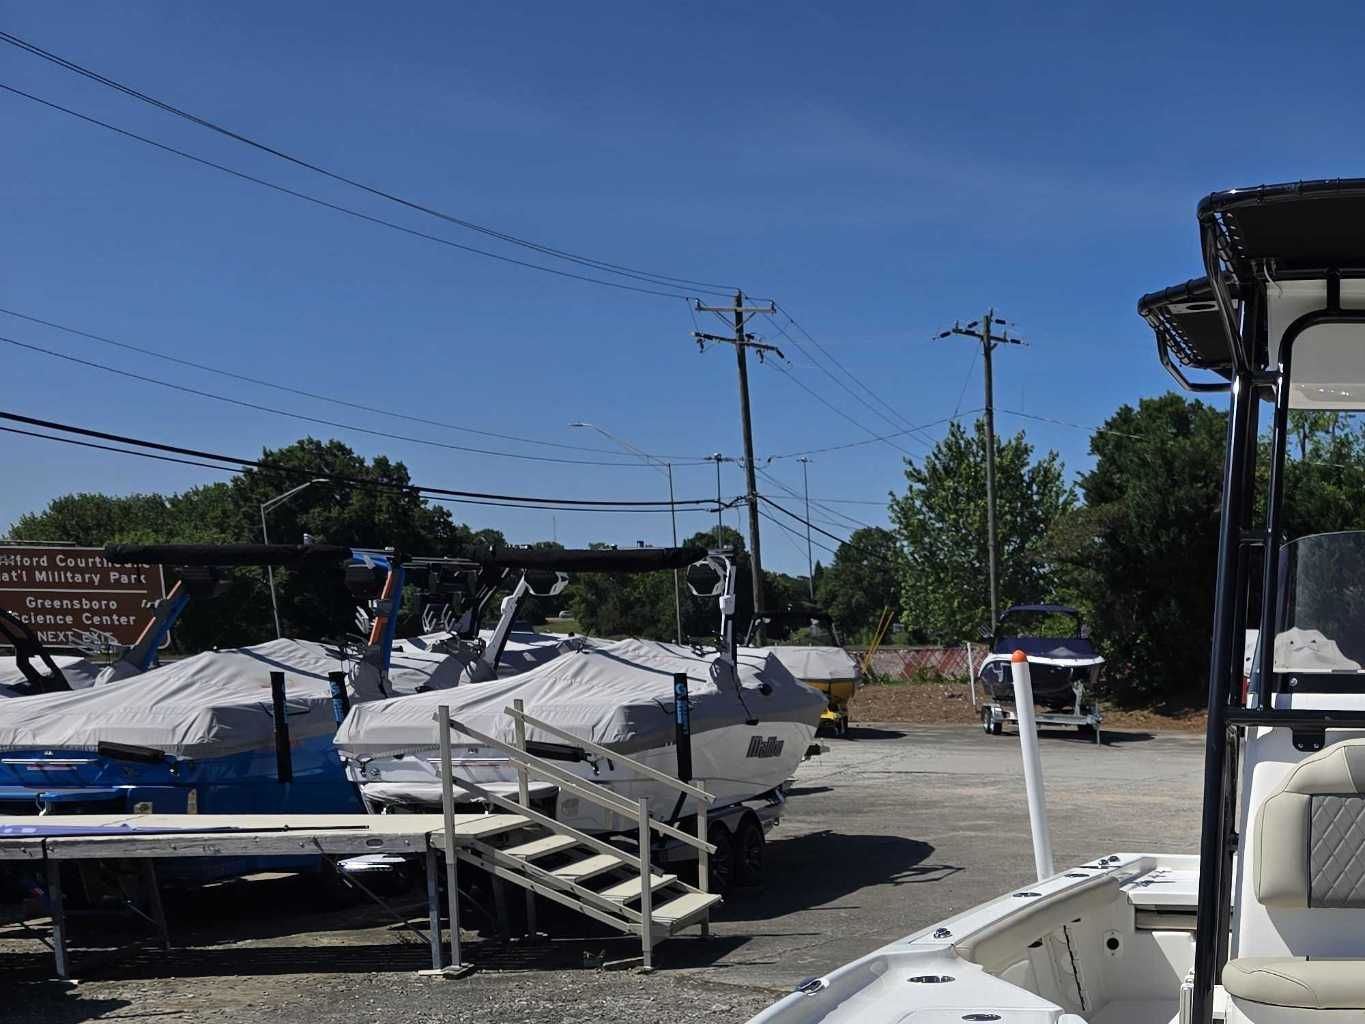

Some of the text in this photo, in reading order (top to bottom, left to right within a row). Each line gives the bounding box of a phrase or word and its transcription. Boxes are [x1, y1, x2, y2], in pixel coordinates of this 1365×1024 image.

[56, 554, 151, 568] Courth
[0, 570, 27, 582] at'l
[34, 570, 101, 586] Military
[25, 596, 118, 610] Greensboro
[82, 612, 136, 625] Center
[37, 631, 74, 642] NEXT
